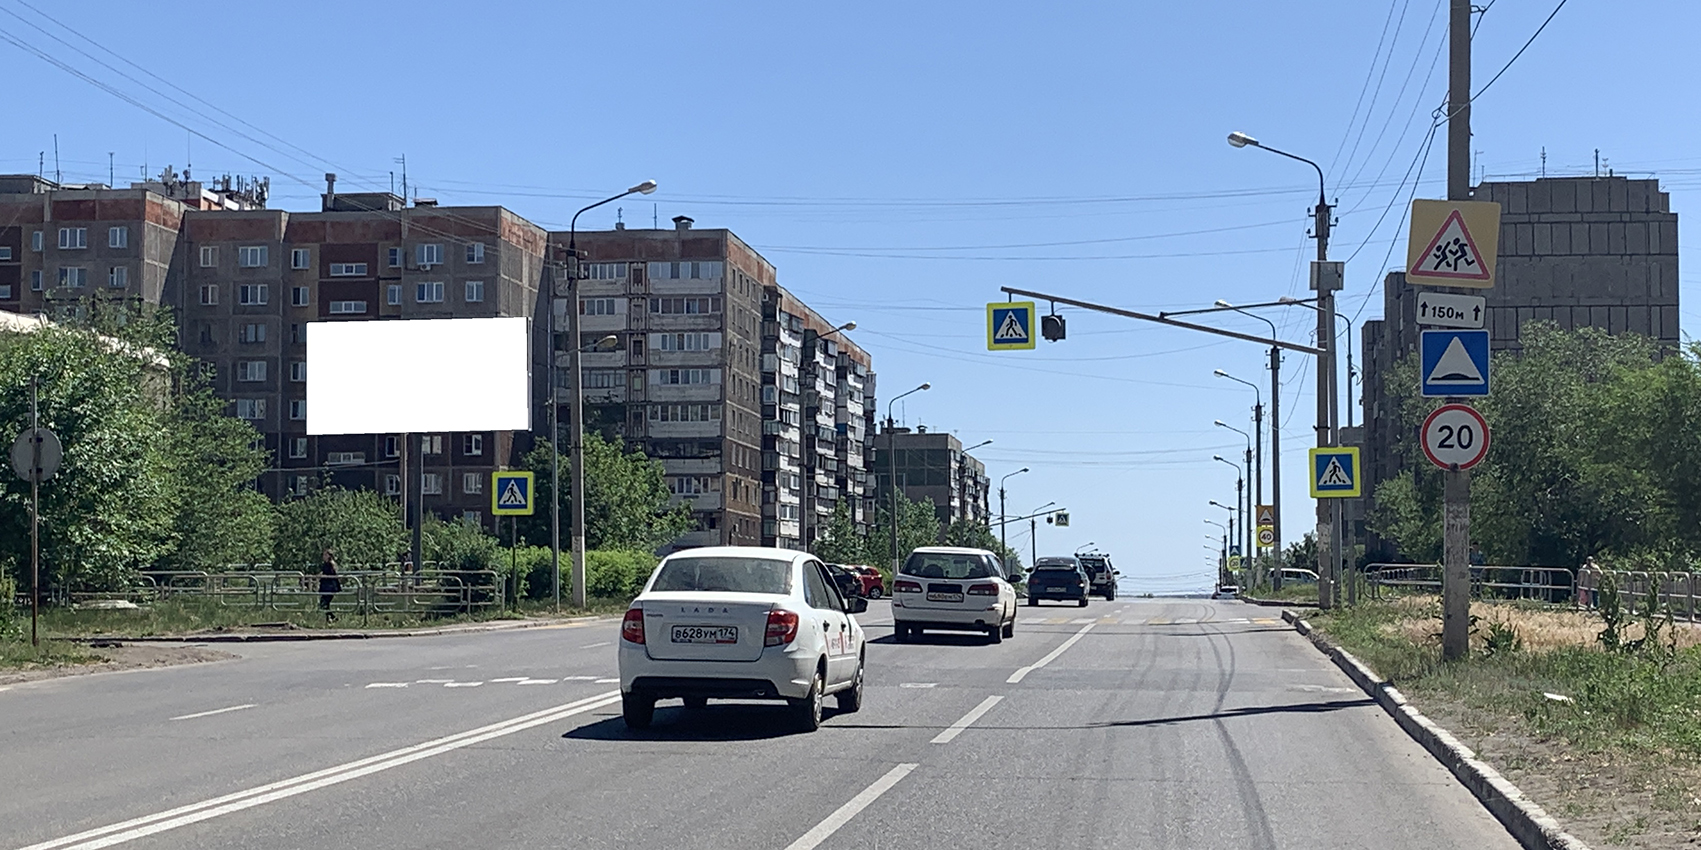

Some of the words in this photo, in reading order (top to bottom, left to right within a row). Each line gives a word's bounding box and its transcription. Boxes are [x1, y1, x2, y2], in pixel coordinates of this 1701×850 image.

[1431, 306, 1464, 320] 150м
[1437, 424, 1474, 450] 20
[1261, 533, 1272, 541] 40
